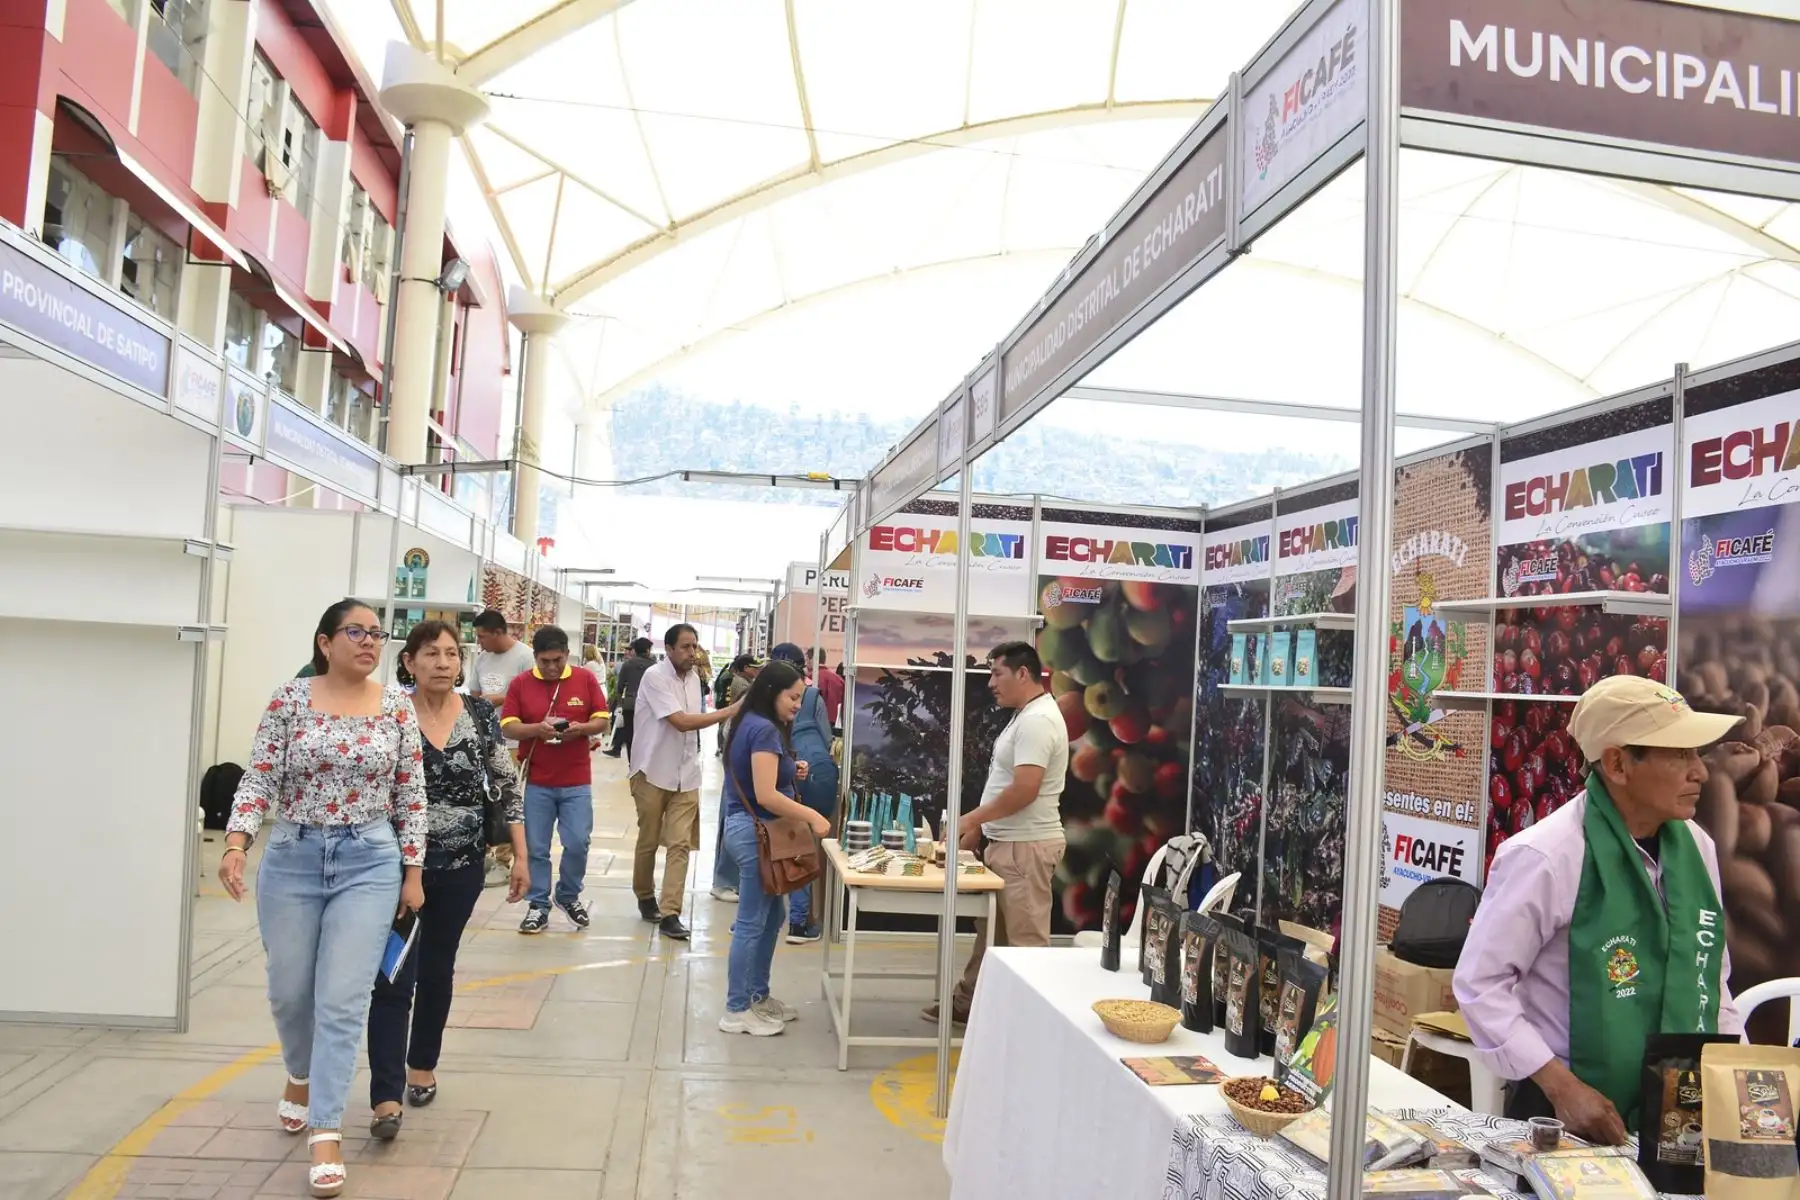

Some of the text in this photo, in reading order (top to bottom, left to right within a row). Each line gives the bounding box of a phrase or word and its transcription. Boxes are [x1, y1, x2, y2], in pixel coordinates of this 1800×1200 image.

[1282, 23, 1357, 123] FICAFÉ
[1449, 19, 1800, 118] MUNICIPALI
[1004, 163, 1223, 397] MUNICIPALIDAD DISTRITAL DE ECHARATI
[3, 269, 158, 373] PROVINCIAL DE SATIPO
[1505, 451, 1663, 522] ECHARATI
[870, 526, 1025, 559] ECHARATI
[1045, 535, 1193, 570] ECHARATI
[1205, 535, 1270, 571] ECHARATI
[1392, 530, 1469, 577] ECHARATI
[1715, 528, 1775, 559] FICAFÉ
[1434, 800, 1452, 818] en
[1455, 800, 1474, 822] el:
[1394, 833, 1464, 878] FICAFÉ
[1601, 934, 1637, 953] ECHARATI
[1616, 987, 1637, 999] 2022
